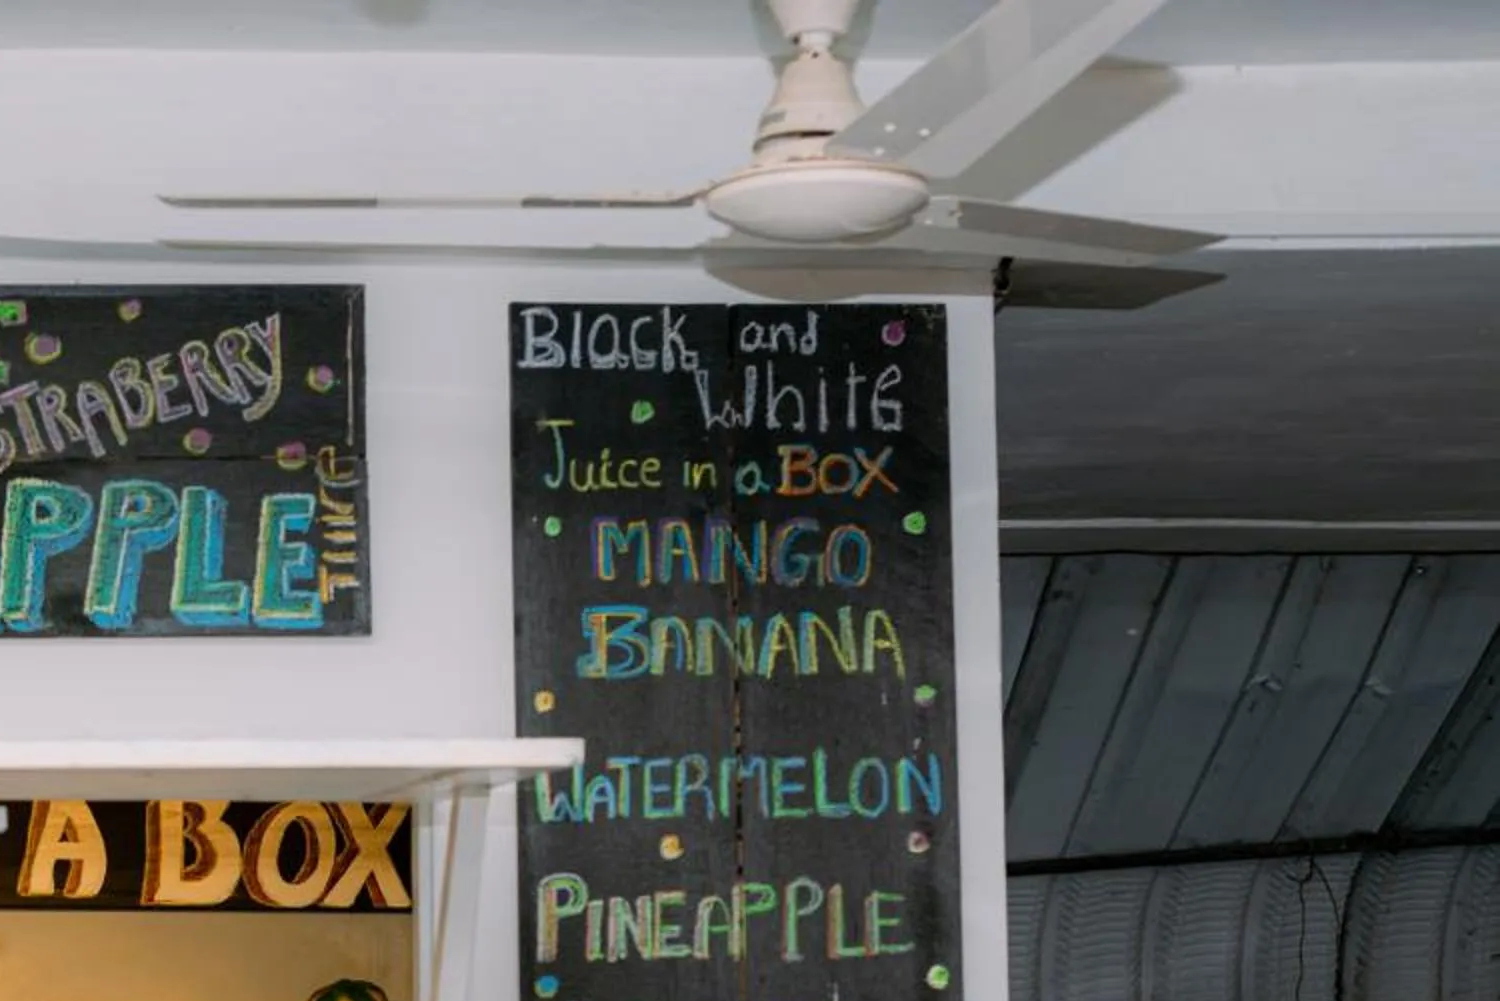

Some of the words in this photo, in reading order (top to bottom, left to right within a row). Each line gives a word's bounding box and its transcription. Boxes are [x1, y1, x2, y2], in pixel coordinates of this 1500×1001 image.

[740, 313, 819, 355] and
[537, 420, 662, 492] Juice
[684, 460, 717, 488] in
[735, 462, 770, 495] a
[776, 445, 899, 496] BOX
[594, 517, 872, 587] MANGO
[576, 605, 905, 679] BANANA
[535, 746, 941, 822] WATERMELON
[17, 800, 107, 897] A
[140, 800, 413, 908] BOX
[536, 873, 915, 962] PINEAPPLE
